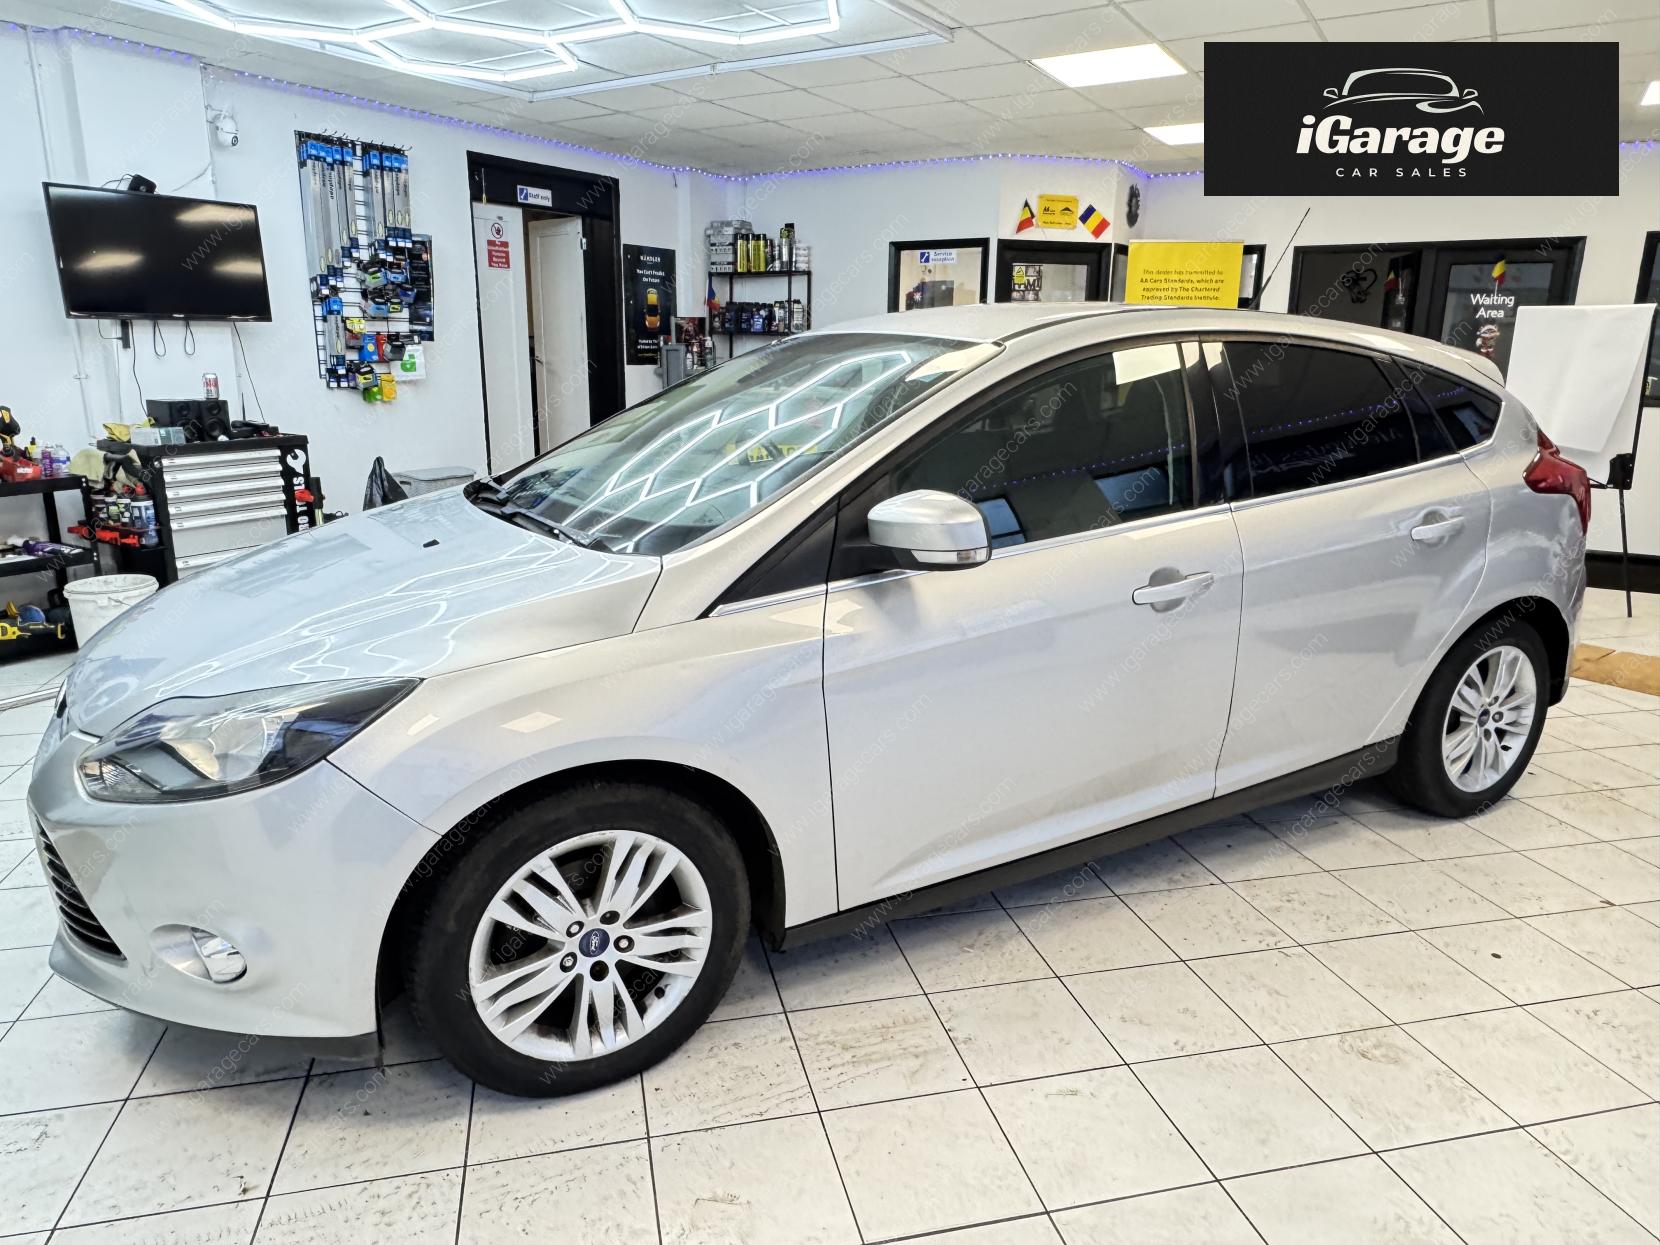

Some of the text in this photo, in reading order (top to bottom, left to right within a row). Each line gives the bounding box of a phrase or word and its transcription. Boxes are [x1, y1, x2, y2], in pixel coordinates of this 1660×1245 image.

[1141, 294, 1163, 302] Trading
[1470, 293, 1515, 307] Waiting
[1475, 306, 1505, 318] Area
